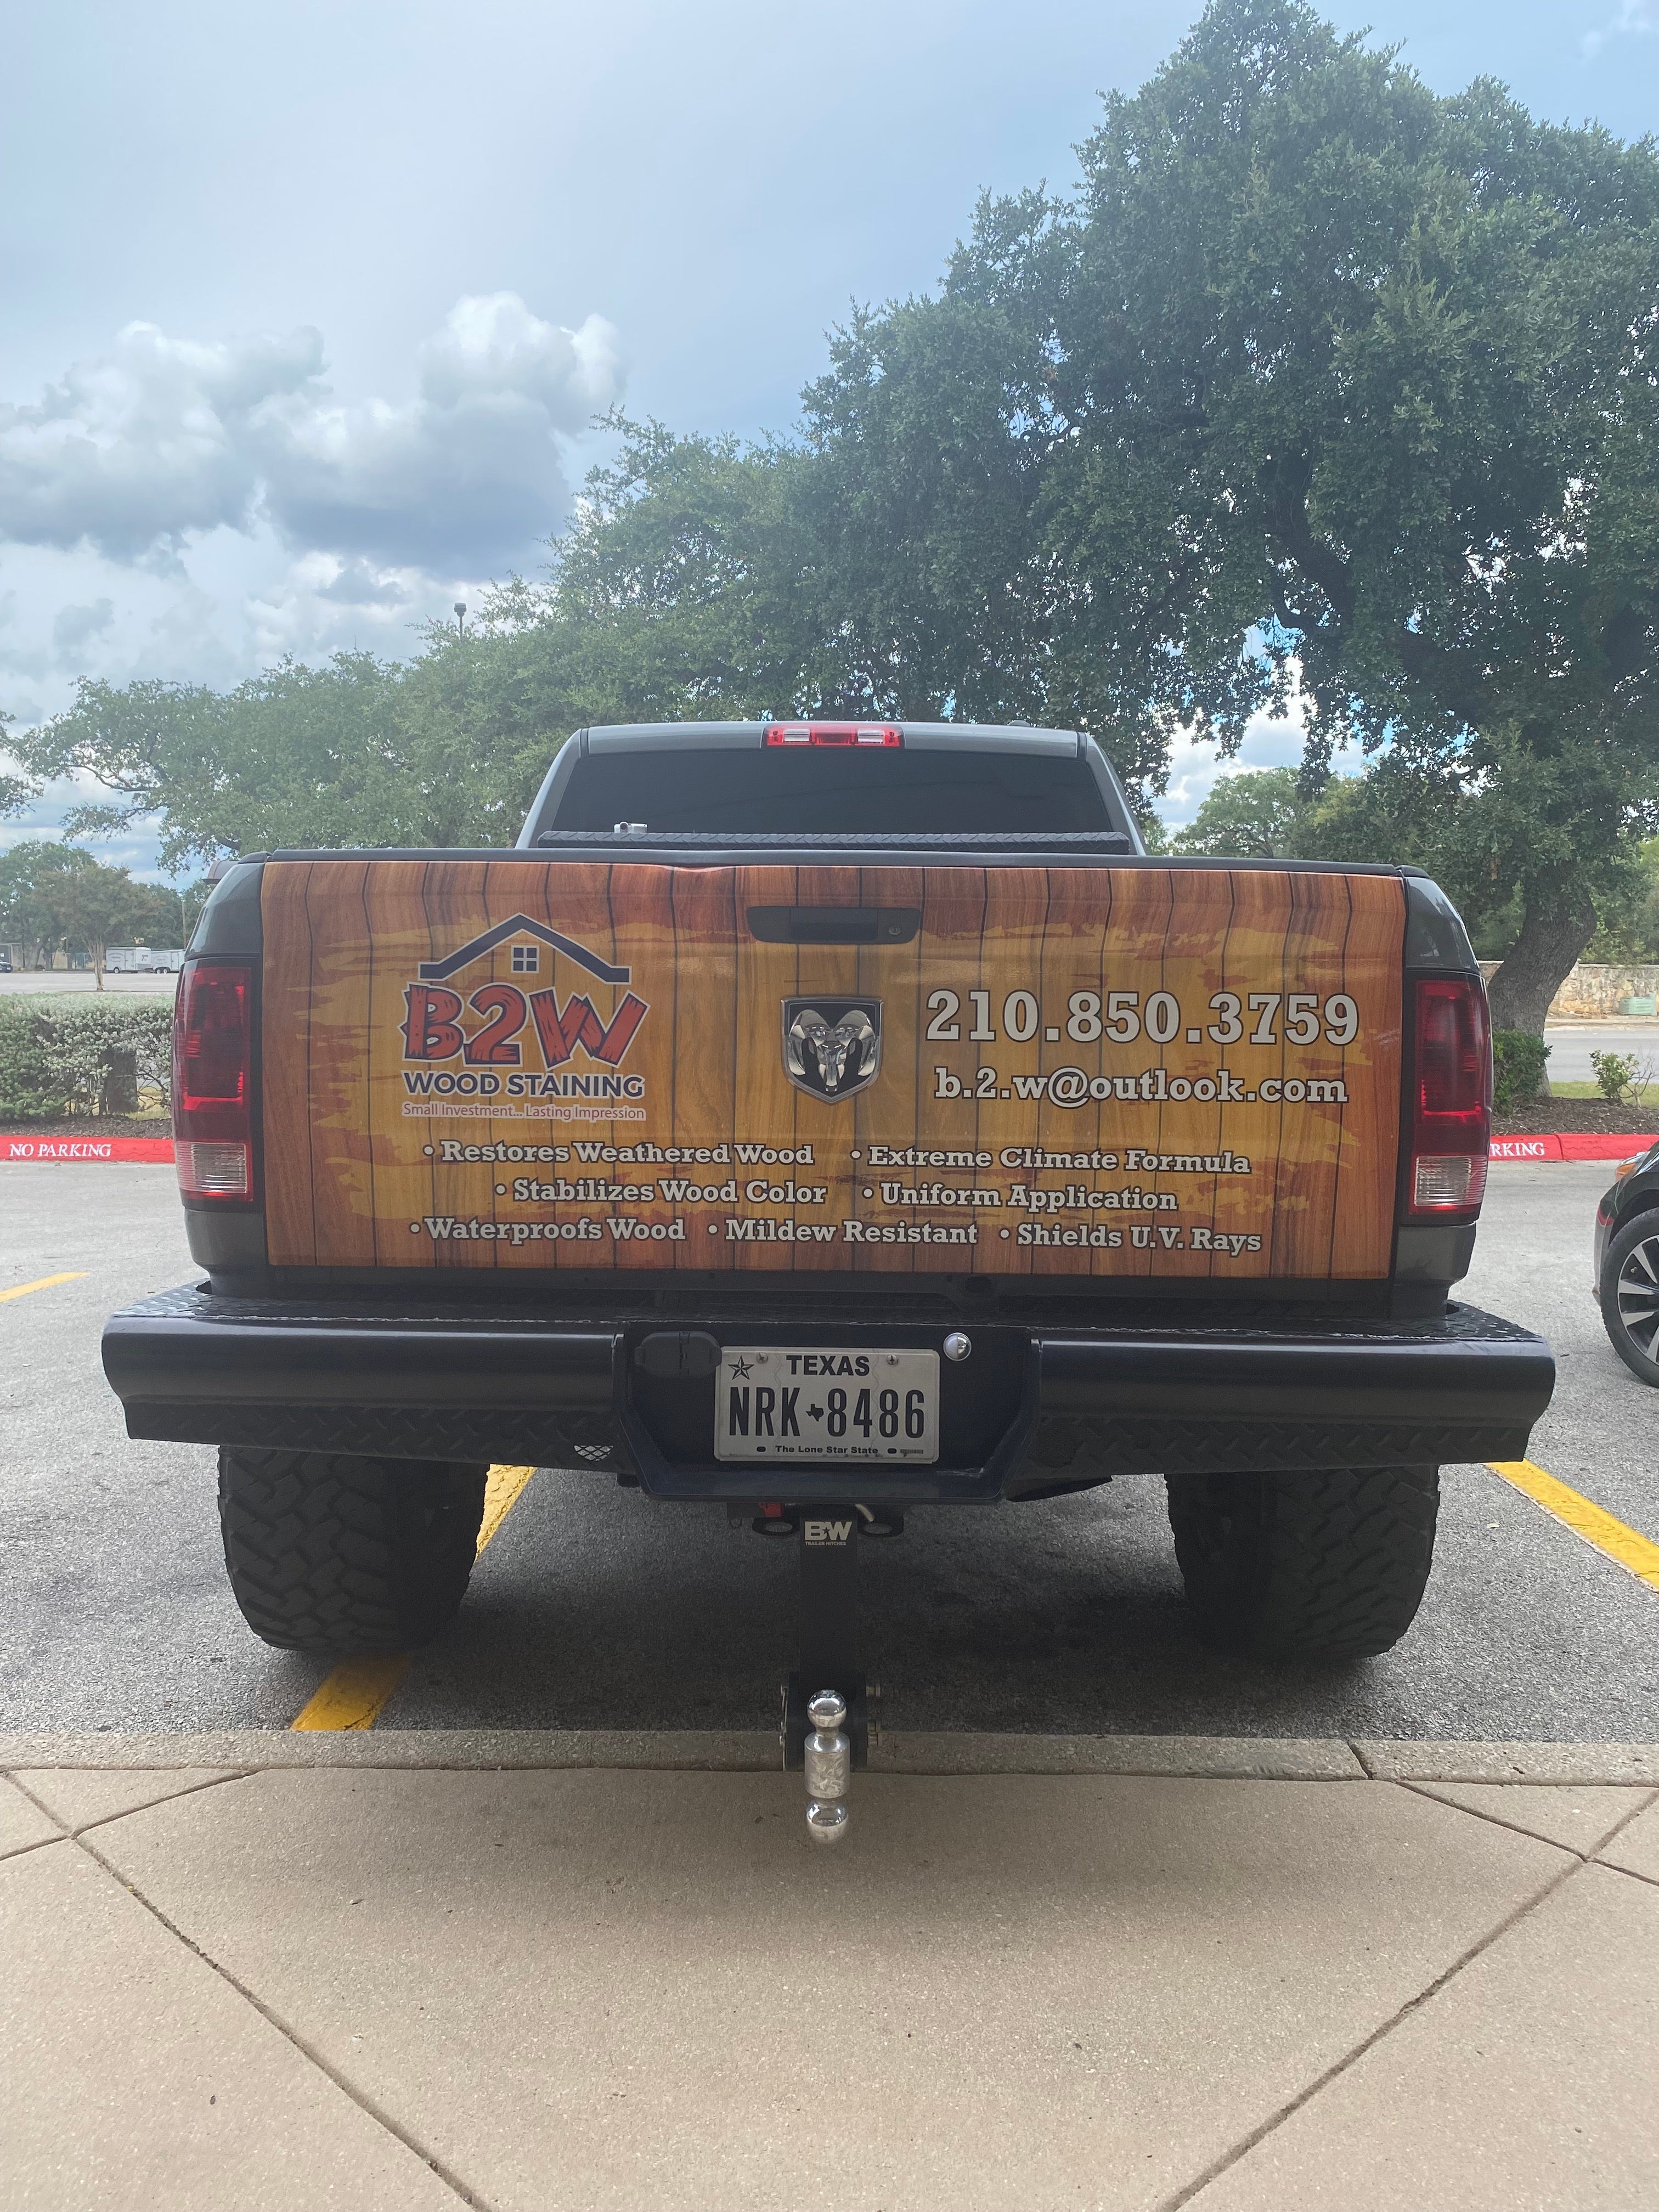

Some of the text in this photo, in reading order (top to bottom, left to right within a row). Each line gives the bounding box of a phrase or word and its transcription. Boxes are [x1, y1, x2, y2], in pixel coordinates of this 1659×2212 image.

[399, 982, 651, 1070] B2W
[926, 989, 1358, 1045] 210.850.3759
[403, 1072, 644, 1098] WOOD STAINING
[934, 1065, 1348, 1108] b.2.w@outlook.com
[403, 1103, 438, 1116] Small
[525, 1105, 571, 1120] Lasting
[575, 1106, 645, 1121] Impression
[9, 1144, 111, 1157] NO PARKING
[441, 1140, 814, 1166] Restores Weathered Wood
[868, 1146, 1251, 1173] Extreme Climate Formula
[1489, 1142, 1545, 1156] RKING
[514, 1177, 827, 1204] Stabilizes Wood Color
[881, 1182, 1177, 1212] Uniform Application
[424, 1218, 686, 1245] Waterproofs Wood
[726, 1219, 977, 1244] Mildew Resistant
[1017, 1224, 1261, 1256] Shields U.V. Rays
[786, 1355, 870, 1376] TEXAS
[729, 1386, 924, 1438] NRK 8486
